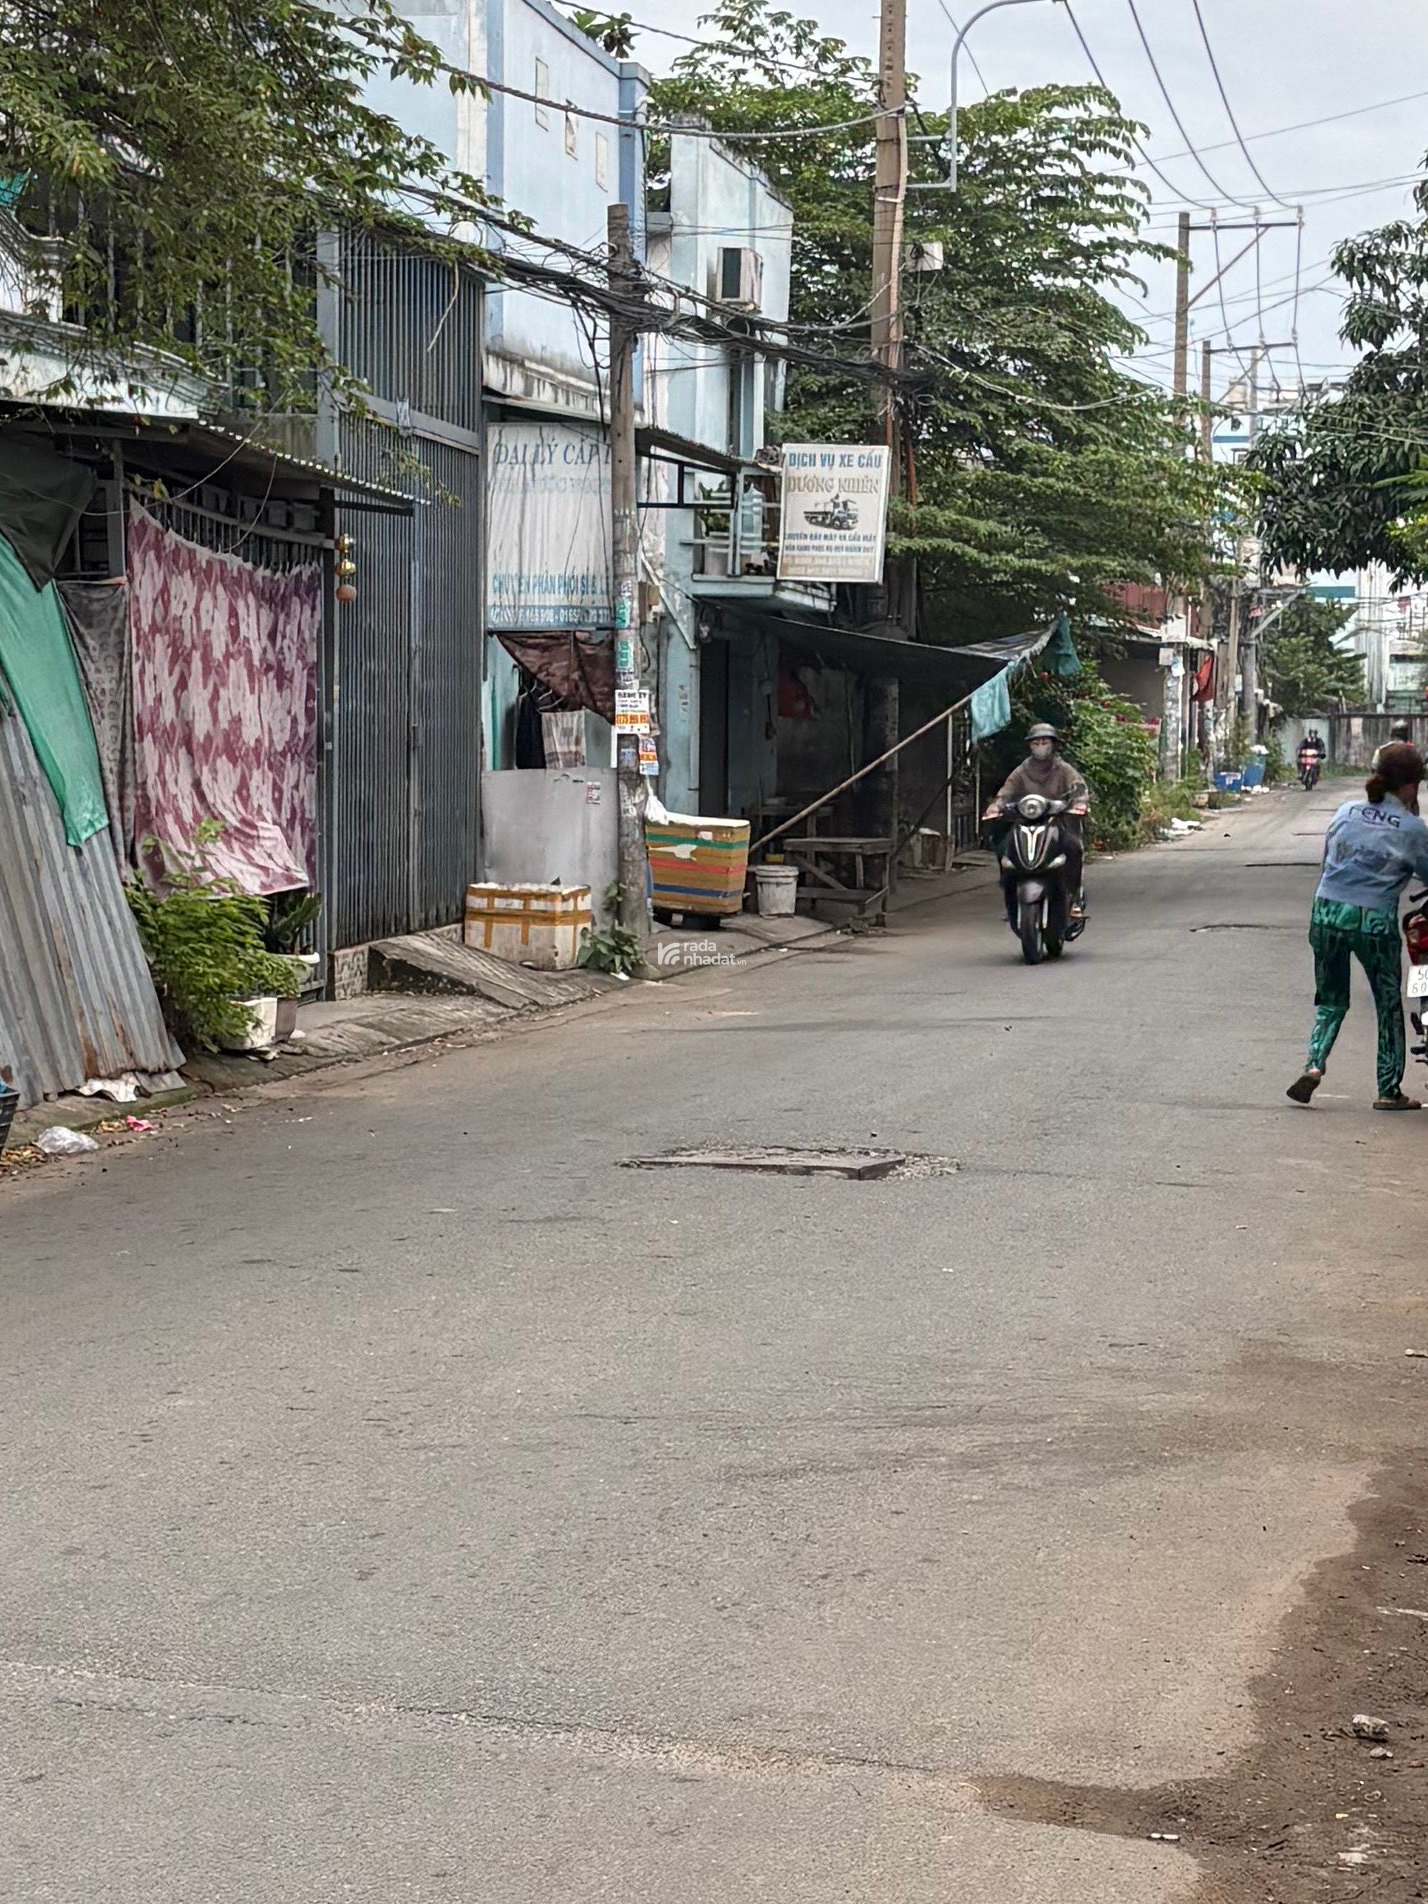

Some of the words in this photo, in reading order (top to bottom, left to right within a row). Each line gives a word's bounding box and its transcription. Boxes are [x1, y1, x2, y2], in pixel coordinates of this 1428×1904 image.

[789, 453, 816, 469] DỊCH
[820, 453, 835, 470] VỤ
[839, 454, 854, 468] XE
